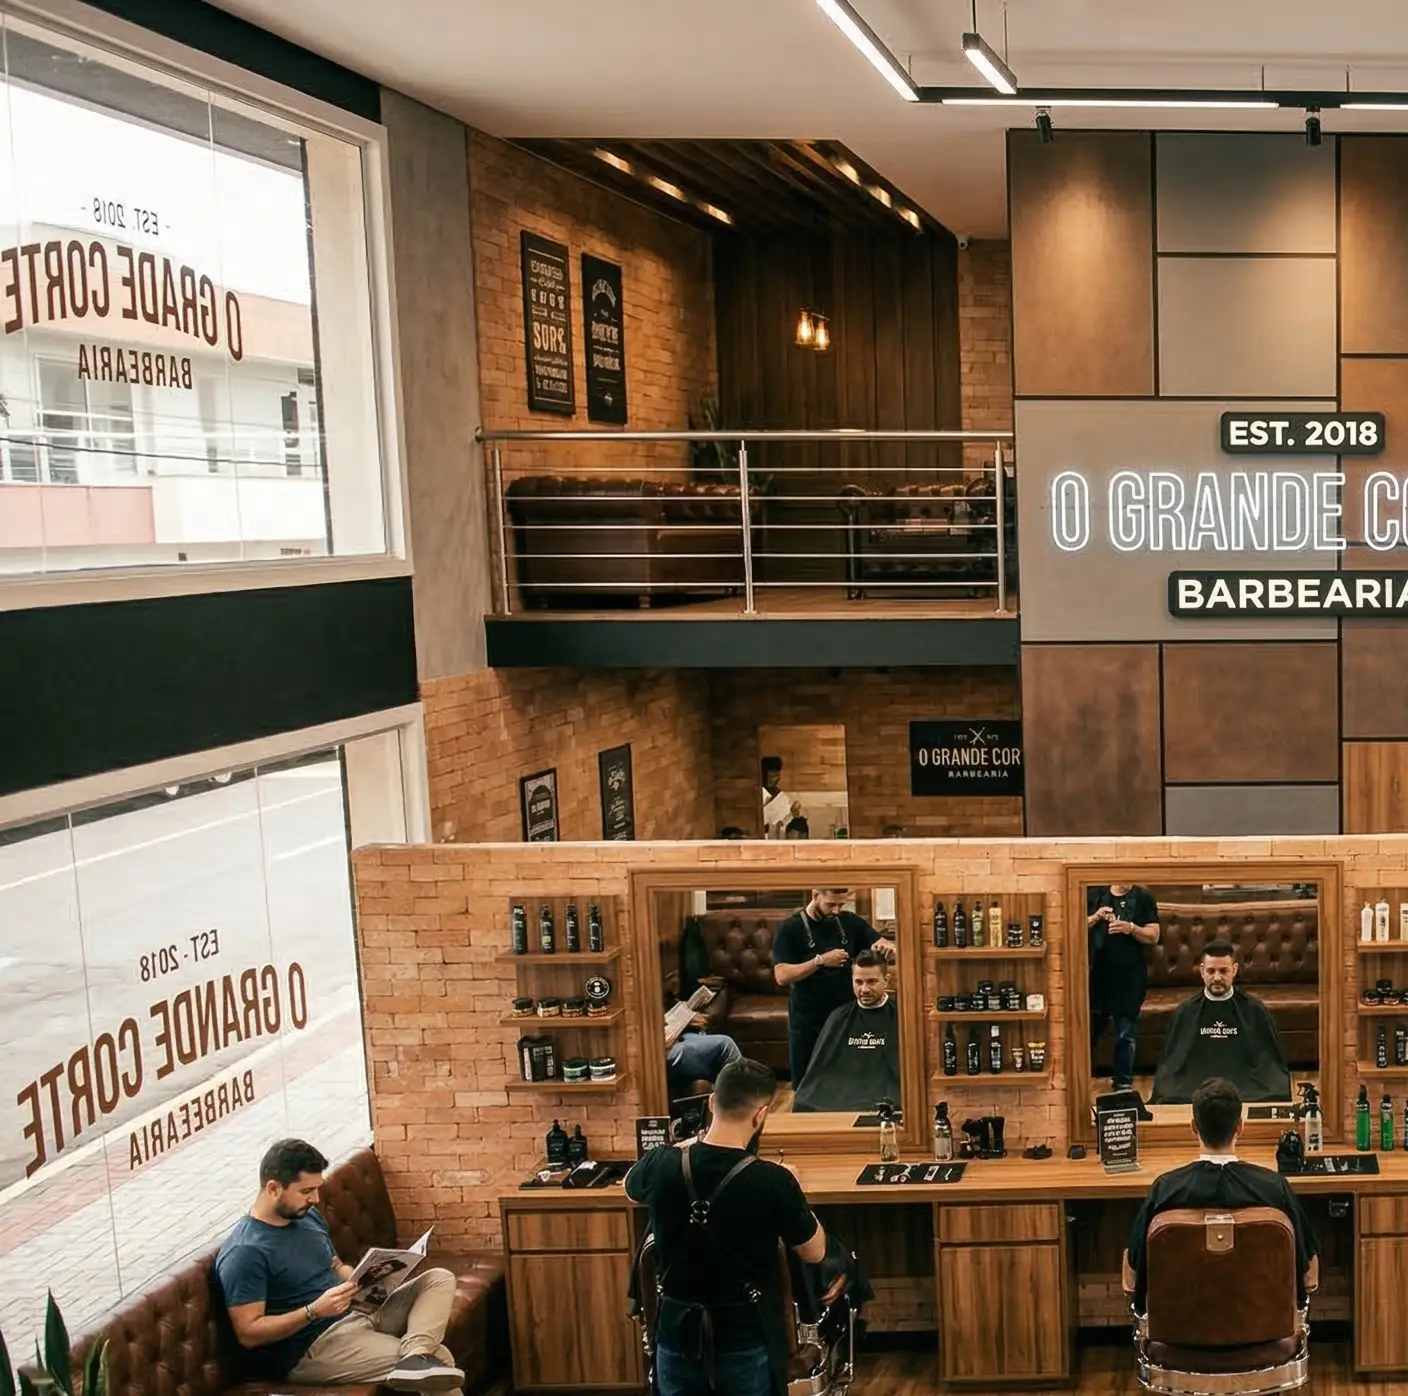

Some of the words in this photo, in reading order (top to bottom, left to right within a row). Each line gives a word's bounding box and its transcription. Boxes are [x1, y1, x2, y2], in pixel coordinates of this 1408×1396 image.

[1229, 420, 1296, 446] EST.
[1305, 420, 1378, 446] 2018
[1051, 470, 1090, 552] O
[1107, 470, 1347, 552] GRANDE
[919, 748, 928, 766] O
[932, 748, 989, 766] GRANDE
